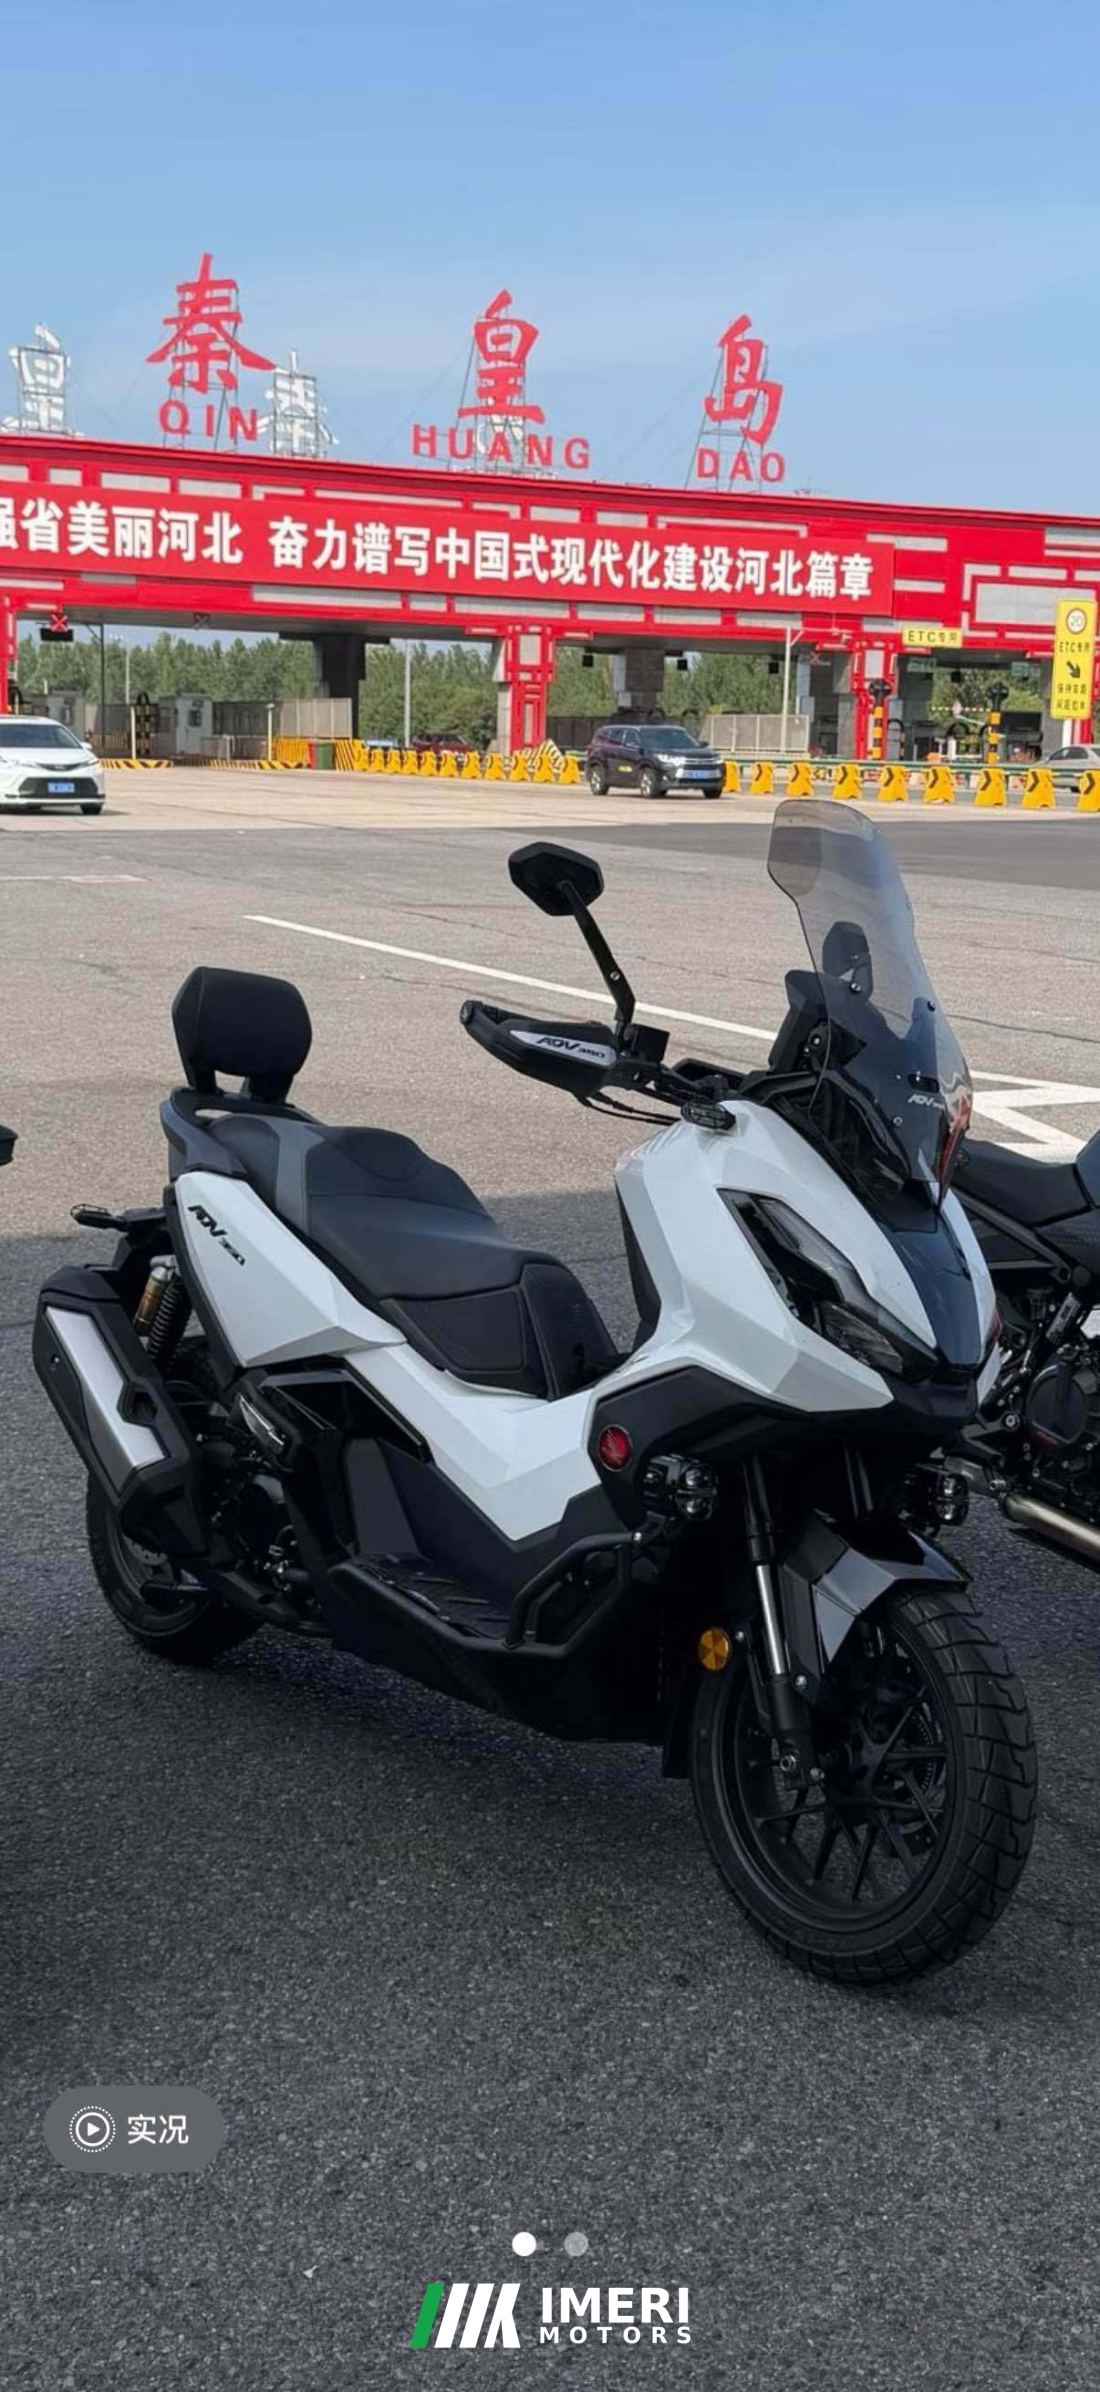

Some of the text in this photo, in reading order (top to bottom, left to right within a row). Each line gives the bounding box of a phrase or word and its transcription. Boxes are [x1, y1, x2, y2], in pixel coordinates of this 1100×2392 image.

[146, 253, 783, 445] 秦 皇 岛
[159, 400, 785, 482] QIN HUANG DAO
[267, 515, 873, 601] 奋力谱写中国式现代化建设河北篇章
[536, 1036, 581, 1051] ADV
[188, 1204, 228, 1237] ADV
